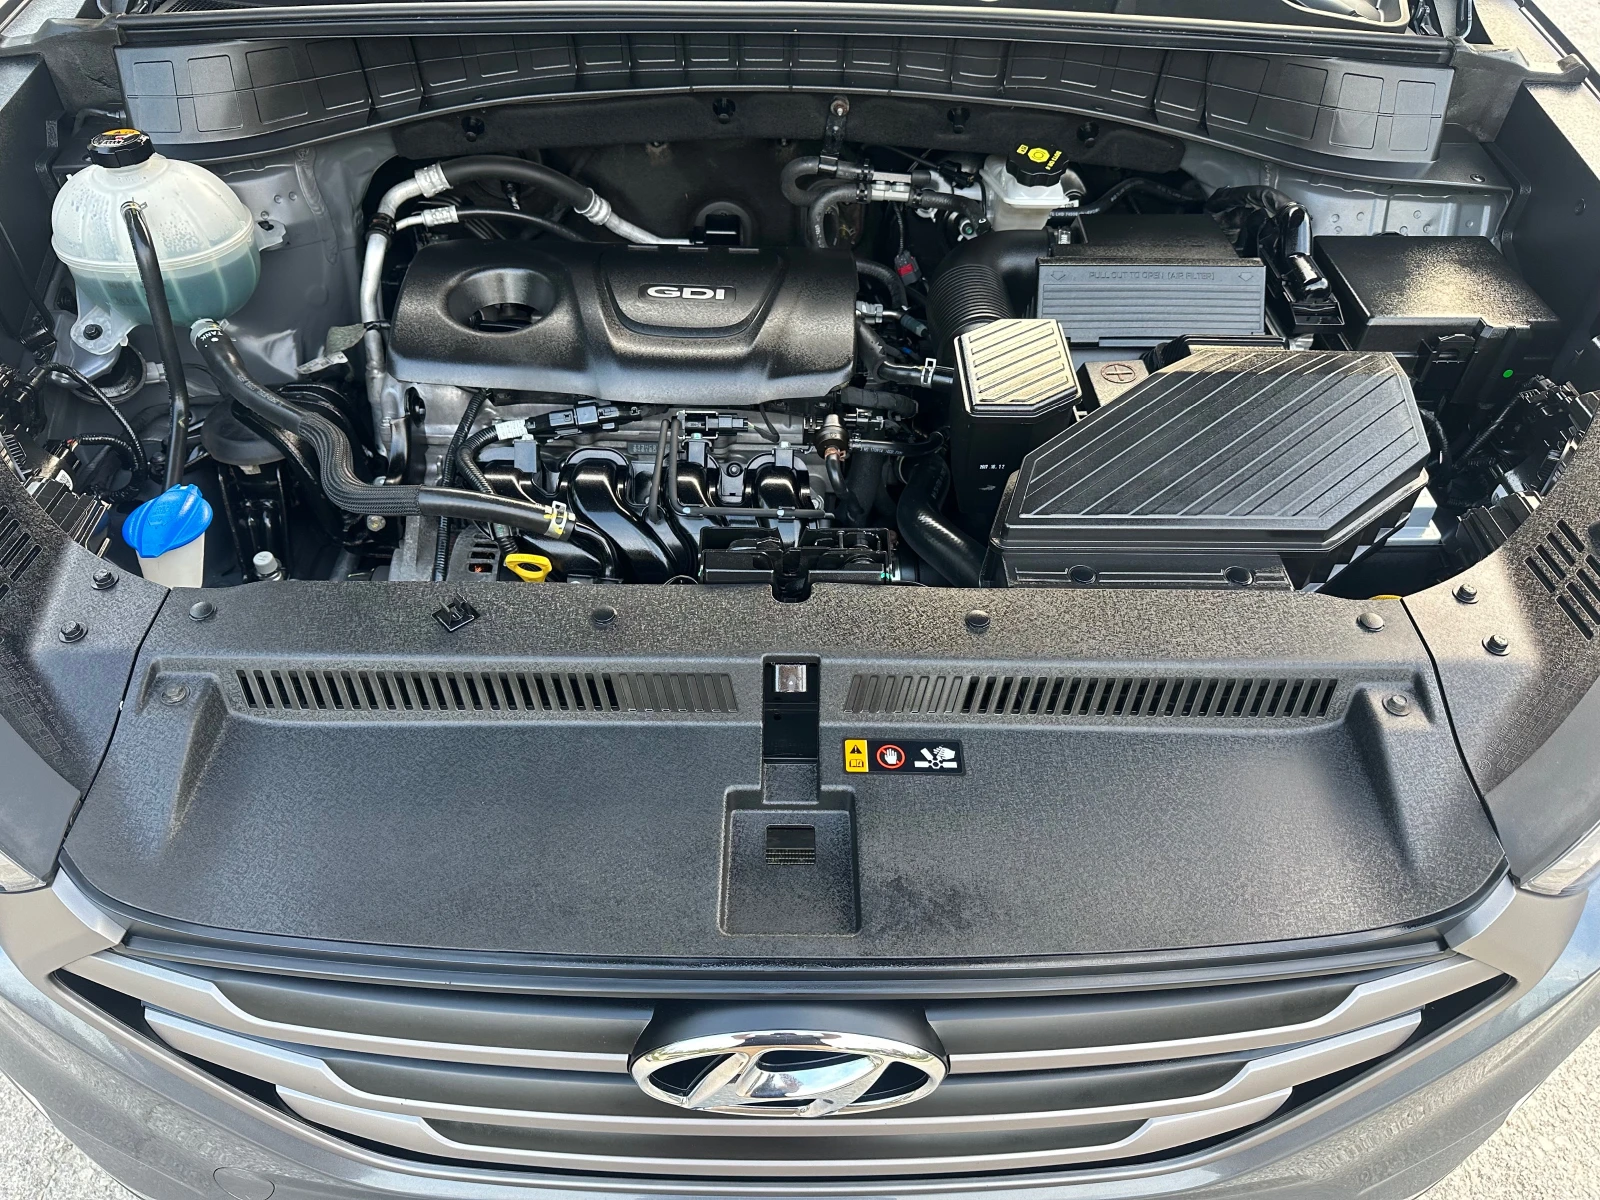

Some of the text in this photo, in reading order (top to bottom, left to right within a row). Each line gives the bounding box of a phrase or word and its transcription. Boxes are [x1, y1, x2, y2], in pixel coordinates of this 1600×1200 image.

[1088, 271, 1109, 279] PULL
[1111, 271, 1128, 279] OUT
[1129, 271, 1140, 279] TO
[1141, 271, 1164, 280] OPEN
[647, 286, 725, 300] GDI
[201, 331, 223, 341] TANK
